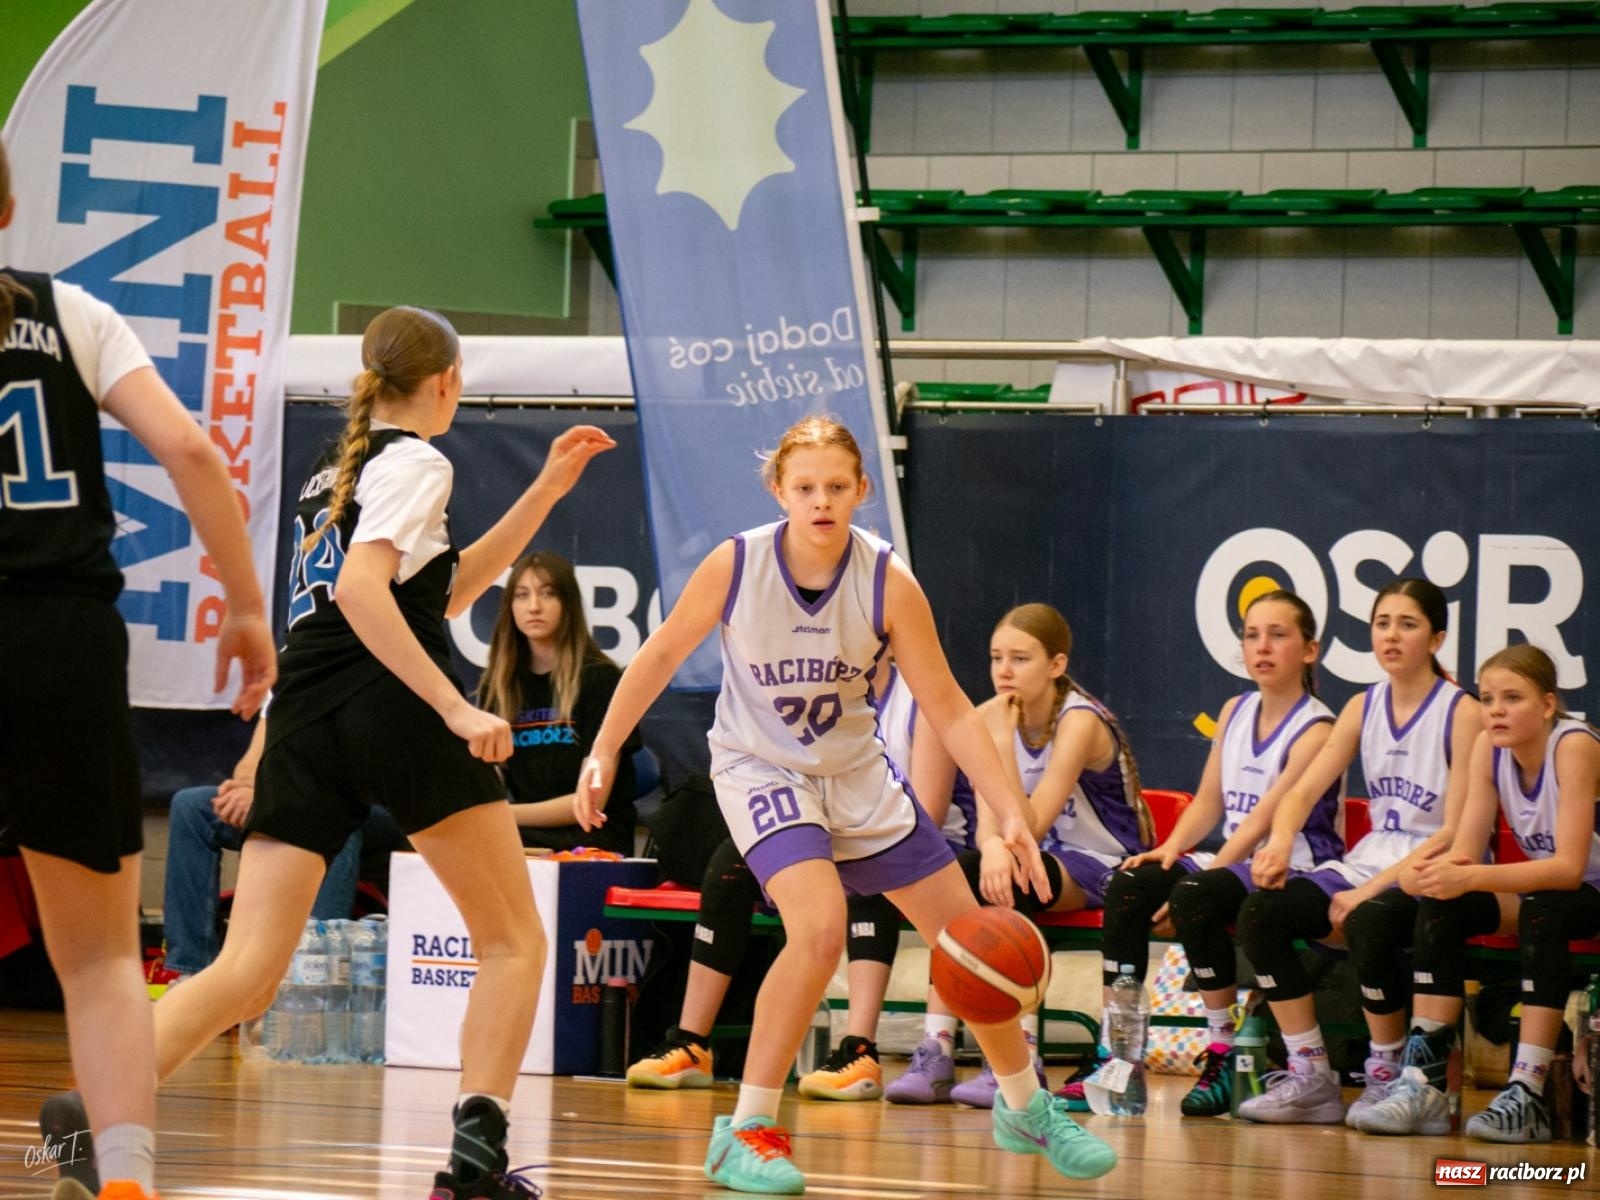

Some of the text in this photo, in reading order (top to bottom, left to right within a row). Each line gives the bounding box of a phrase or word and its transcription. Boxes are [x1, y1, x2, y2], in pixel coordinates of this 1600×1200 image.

[194, 101, 287, 643] BKETBALL
[1195, 527, 1588, 690] OSiR
[773, 692, 843, 746] 20
[747, 785, 801, 836] 20
[412, 933, 475, 958] RACI
